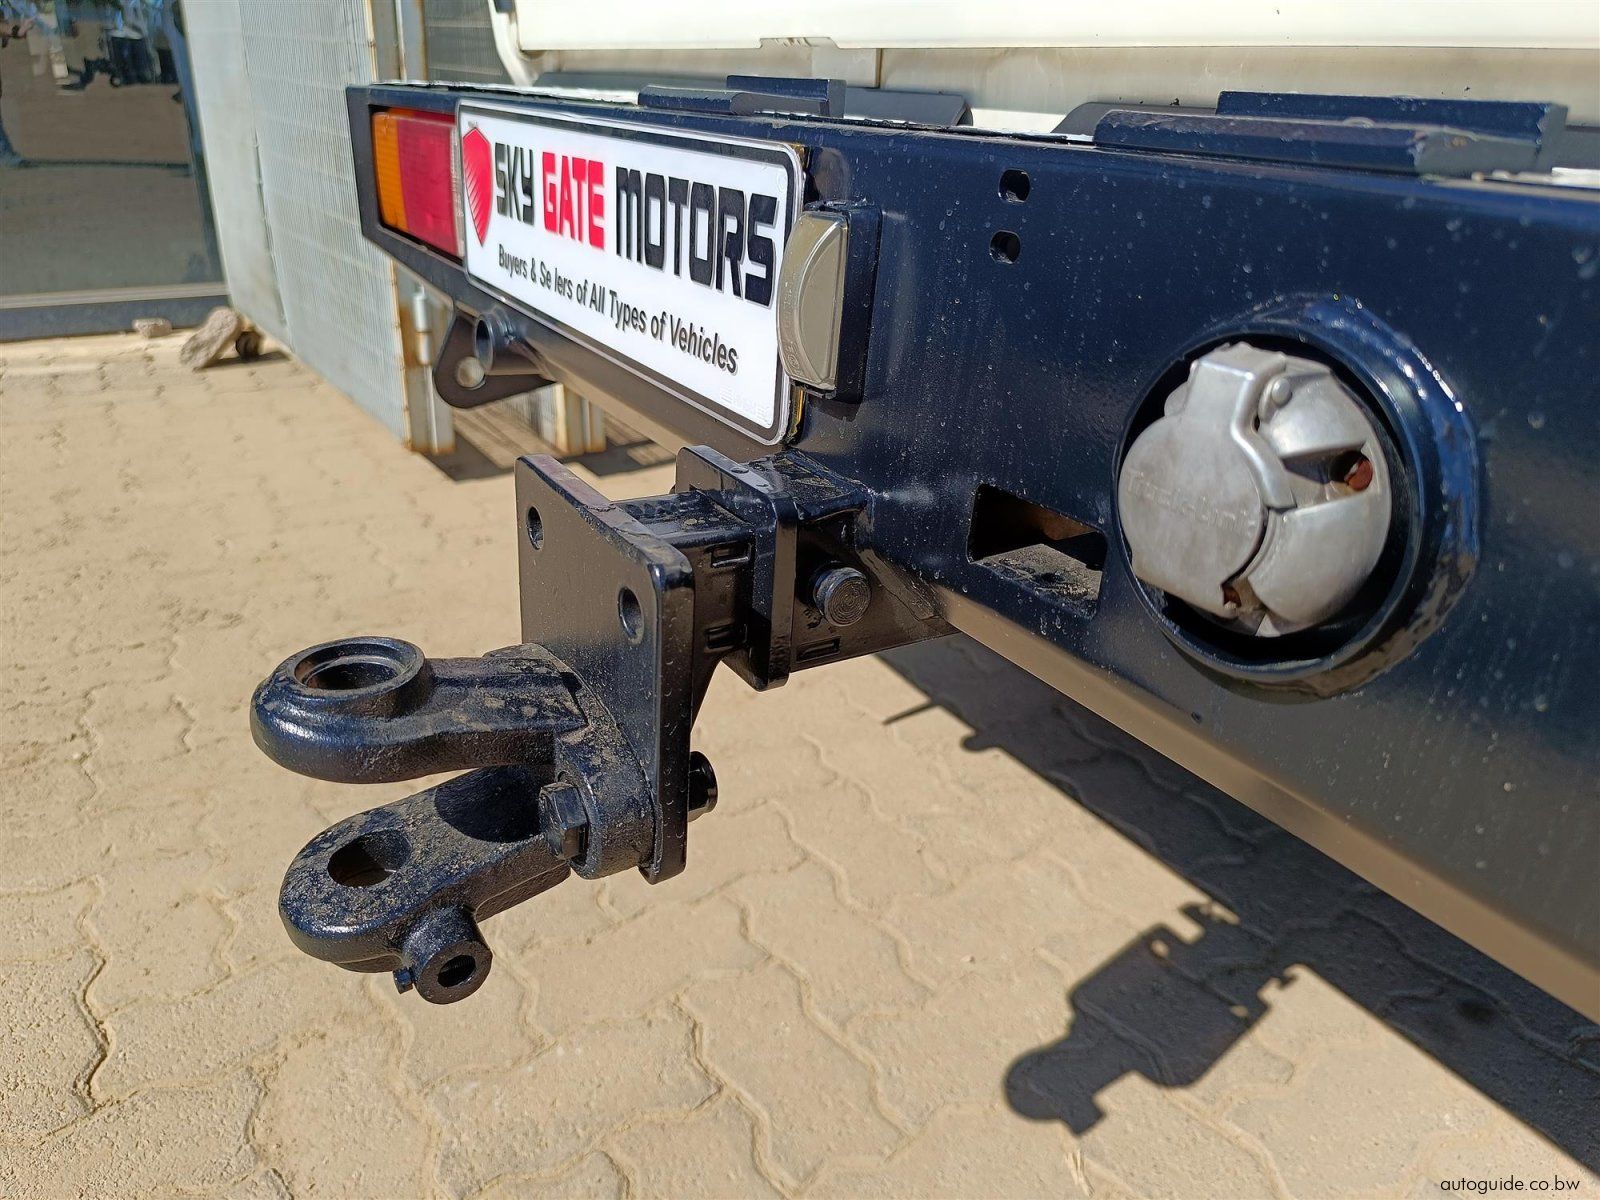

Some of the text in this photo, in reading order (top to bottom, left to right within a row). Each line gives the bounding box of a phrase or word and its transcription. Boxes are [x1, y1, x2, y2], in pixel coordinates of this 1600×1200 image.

[494, 142, 778, 309] SKY GATE MOTORS
[498, 243, 738, 375] Buyers & Selers of All Types of Vehicles
